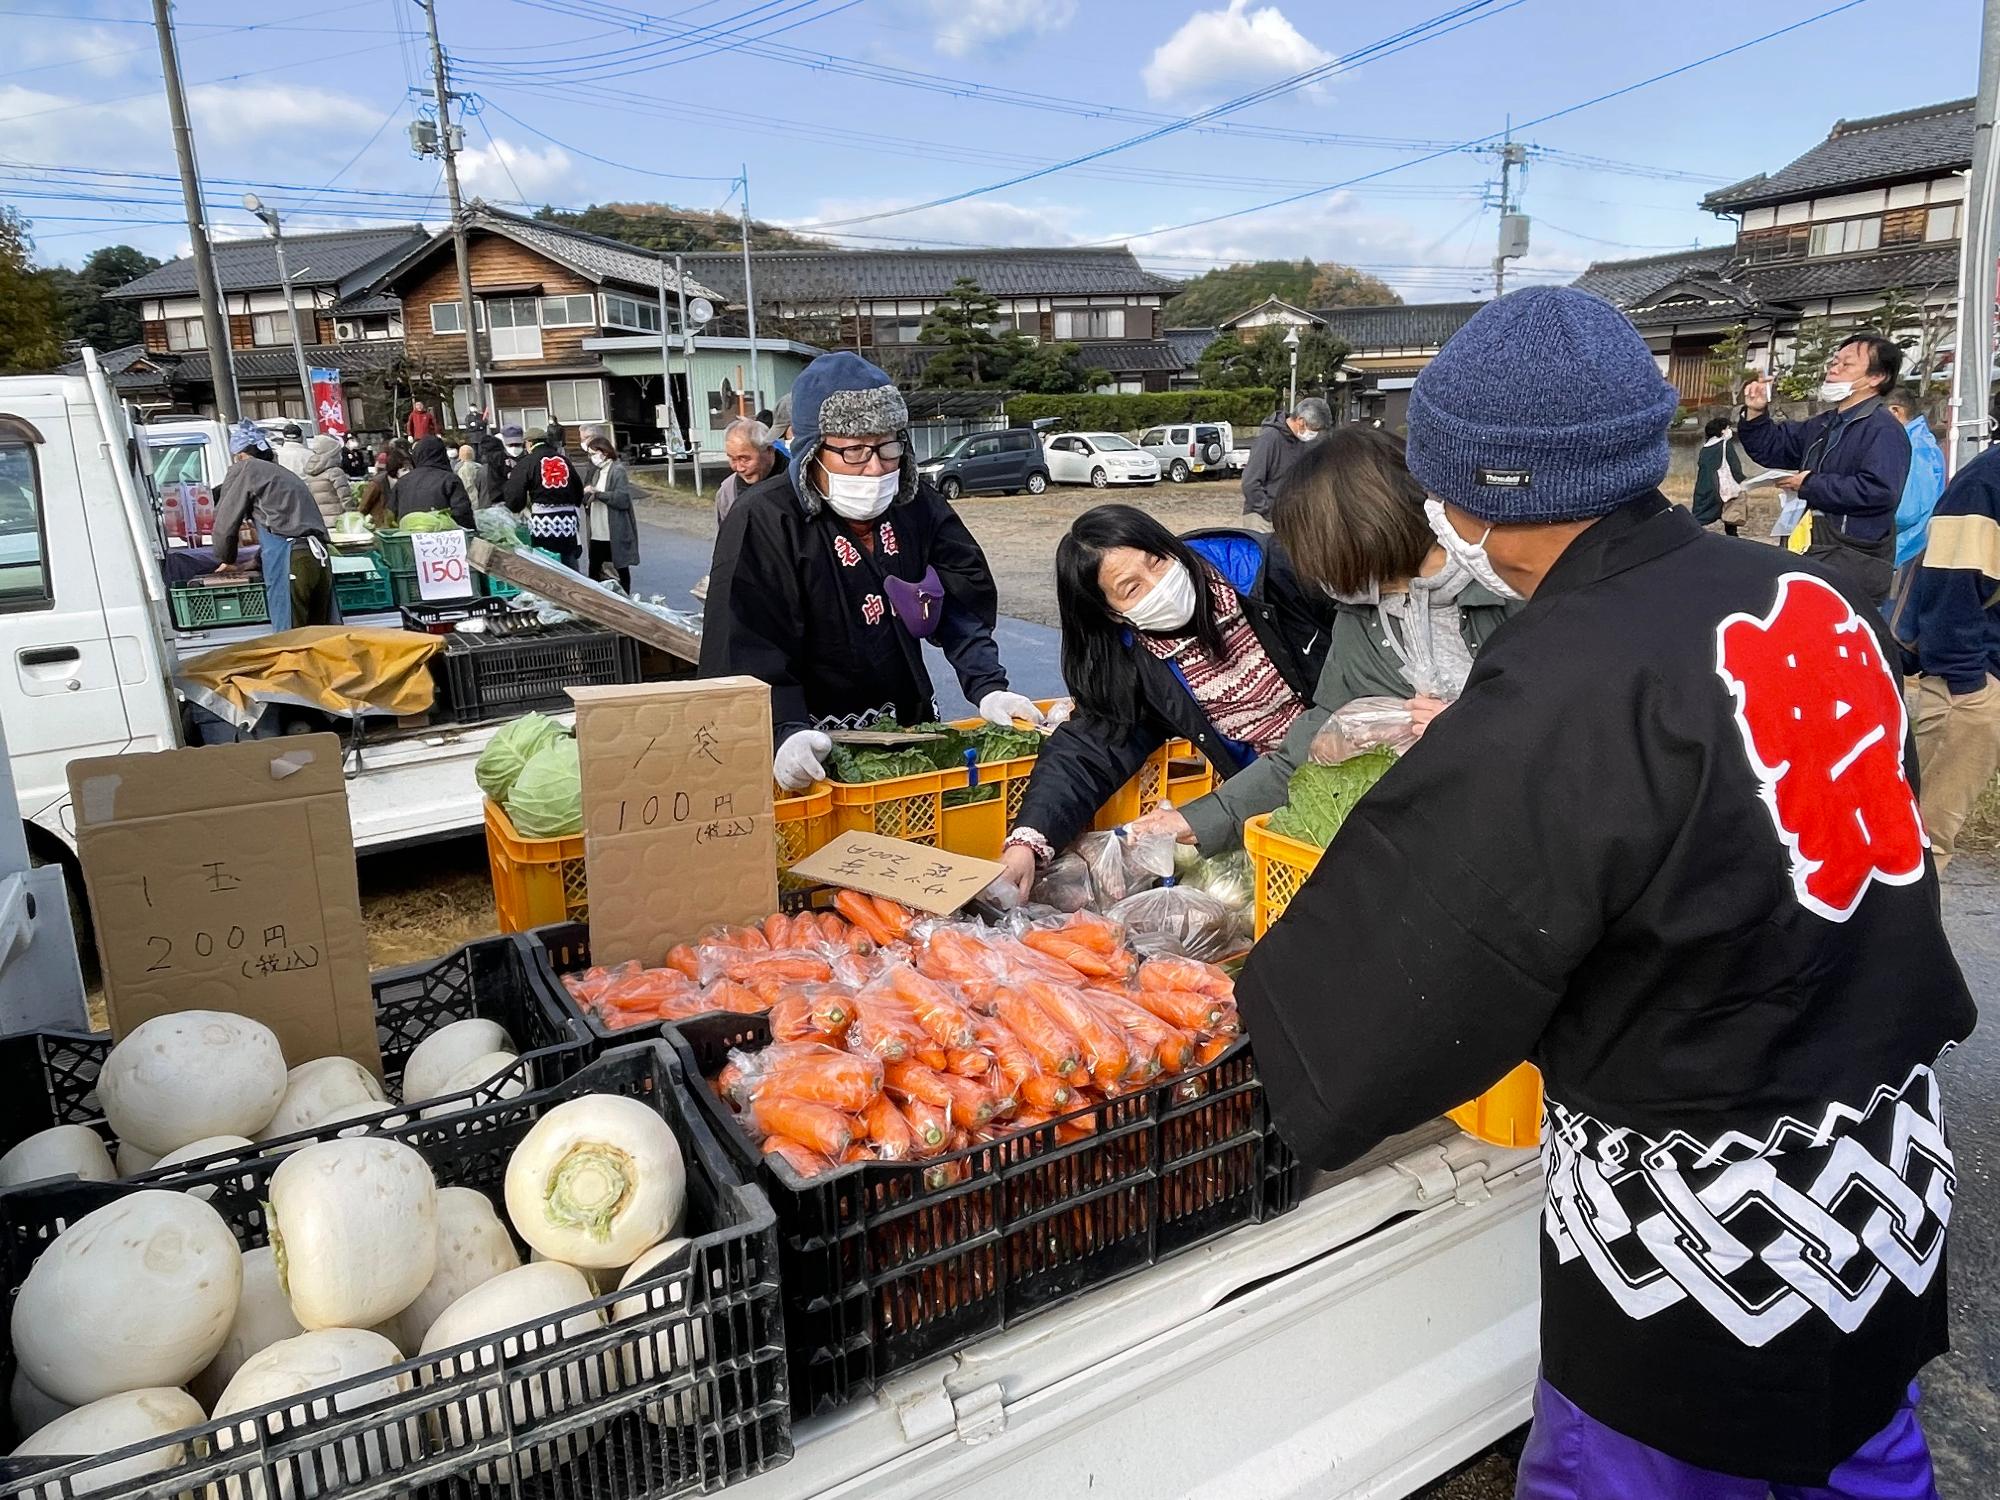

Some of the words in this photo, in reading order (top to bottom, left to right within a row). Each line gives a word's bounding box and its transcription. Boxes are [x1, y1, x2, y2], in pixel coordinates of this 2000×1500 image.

[541, 456, 570, 489] 祭
[422, 558, 463, 584] 150
[1715, 572, 1932, 923] 祭
